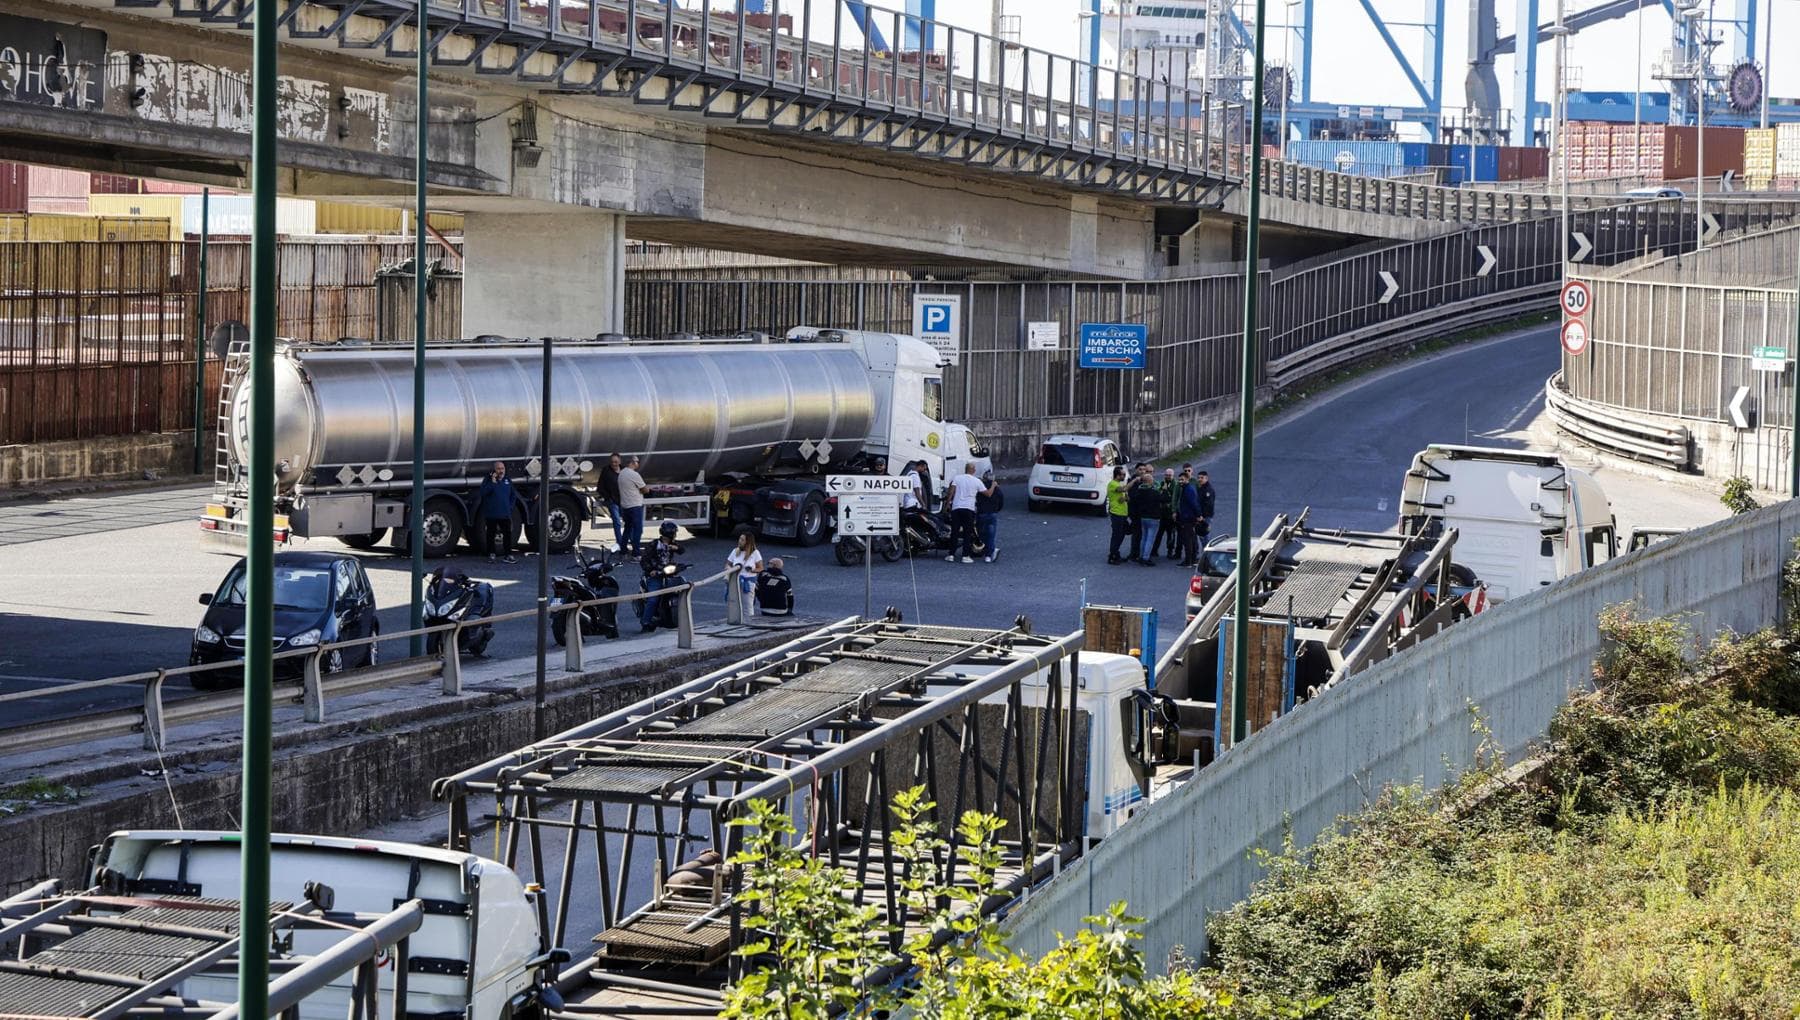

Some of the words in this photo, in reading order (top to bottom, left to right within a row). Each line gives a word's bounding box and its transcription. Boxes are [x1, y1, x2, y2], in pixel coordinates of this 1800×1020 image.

[1567, 290, 1585, 307] 50
[927, 307, 946, 330] P
[1088, 338, 1139, 347] IMBARCO
[1085, 346, 1104, 354] PER
[1106, 347, 1142, 355] ISCHIA
[863, 480, 912, 490] NAPOLI
